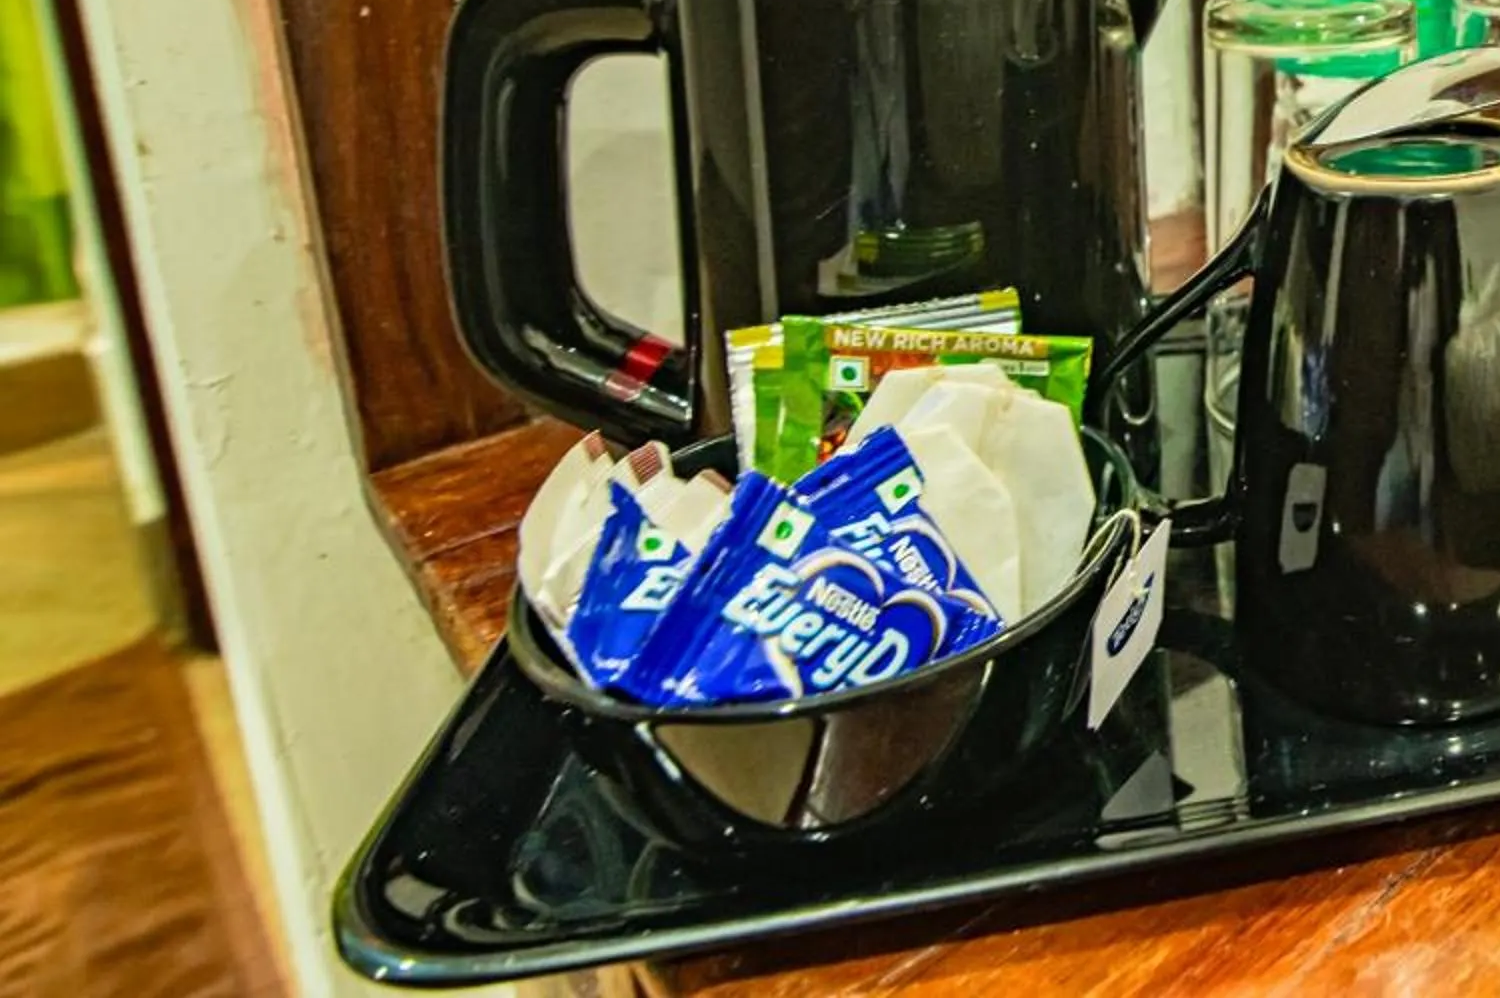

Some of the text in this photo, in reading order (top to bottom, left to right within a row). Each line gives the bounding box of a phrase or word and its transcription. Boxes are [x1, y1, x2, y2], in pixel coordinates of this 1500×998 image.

[833, 328, 1034, 356] NEW RICH AROMA
